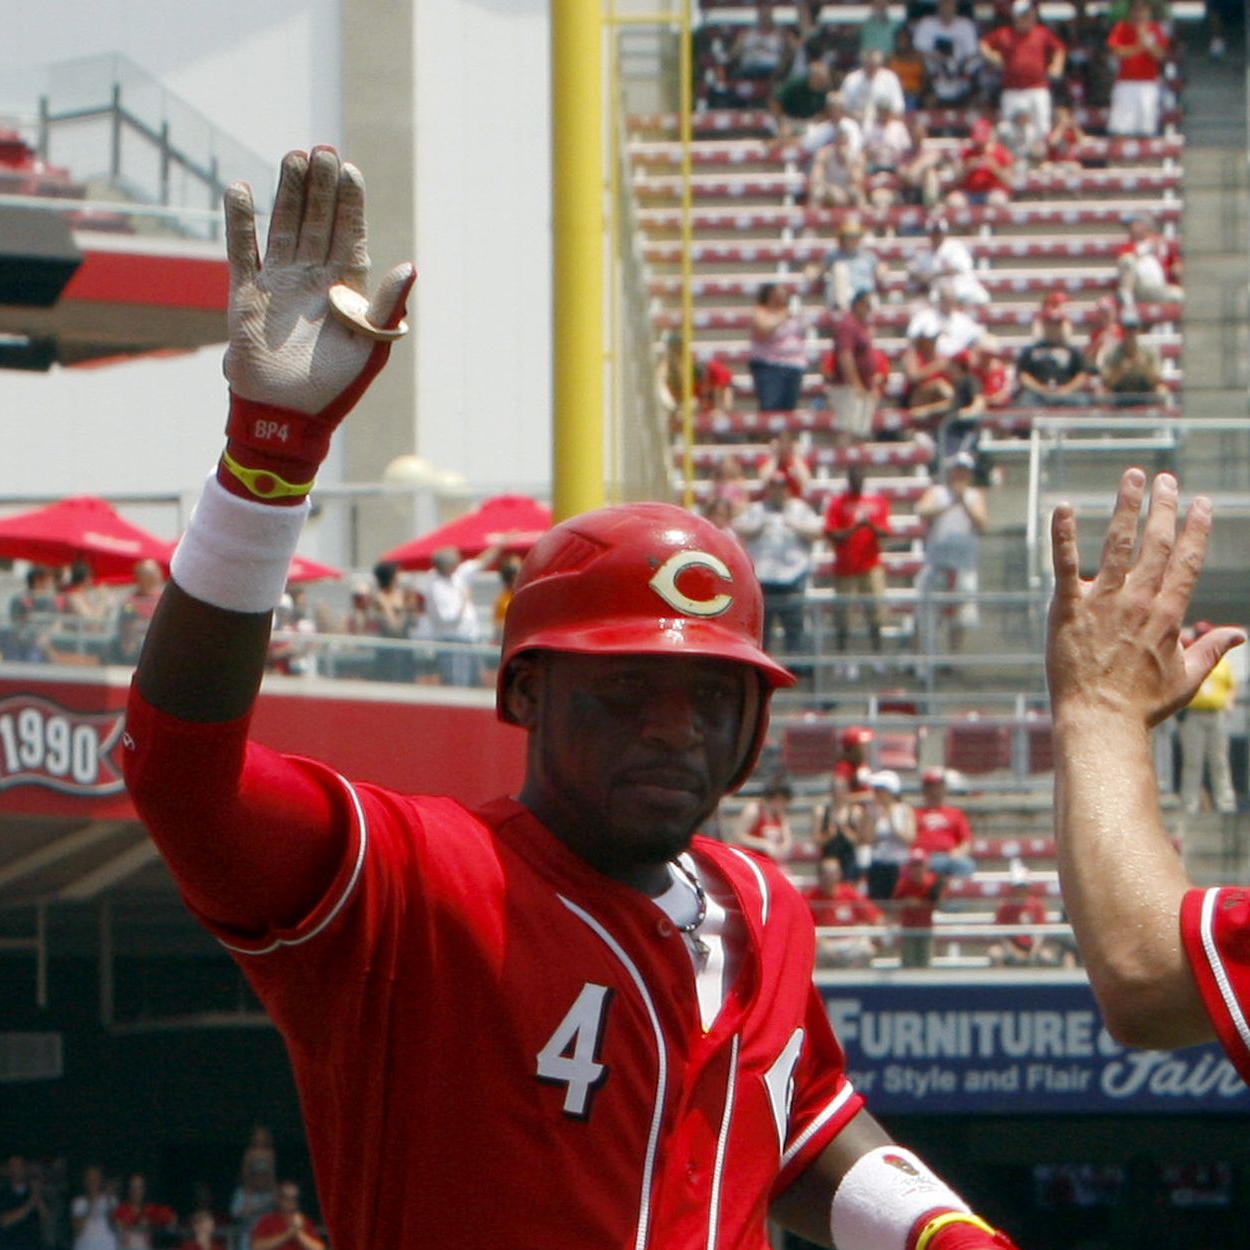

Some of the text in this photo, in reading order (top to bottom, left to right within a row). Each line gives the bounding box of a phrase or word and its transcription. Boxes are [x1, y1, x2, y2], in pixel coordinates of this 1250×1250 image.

[254, 419, 290, 443] BP4
[649, 550, 733, 616] C
[536, 982, 610, 1120] 4
[828, 999, 1095, 1058] FURNITURE
[882, 1064, 956, 1098] Style
[963, 1064, 1019, 1091] and
[1028, 1061, 1091, 1092] Flair
